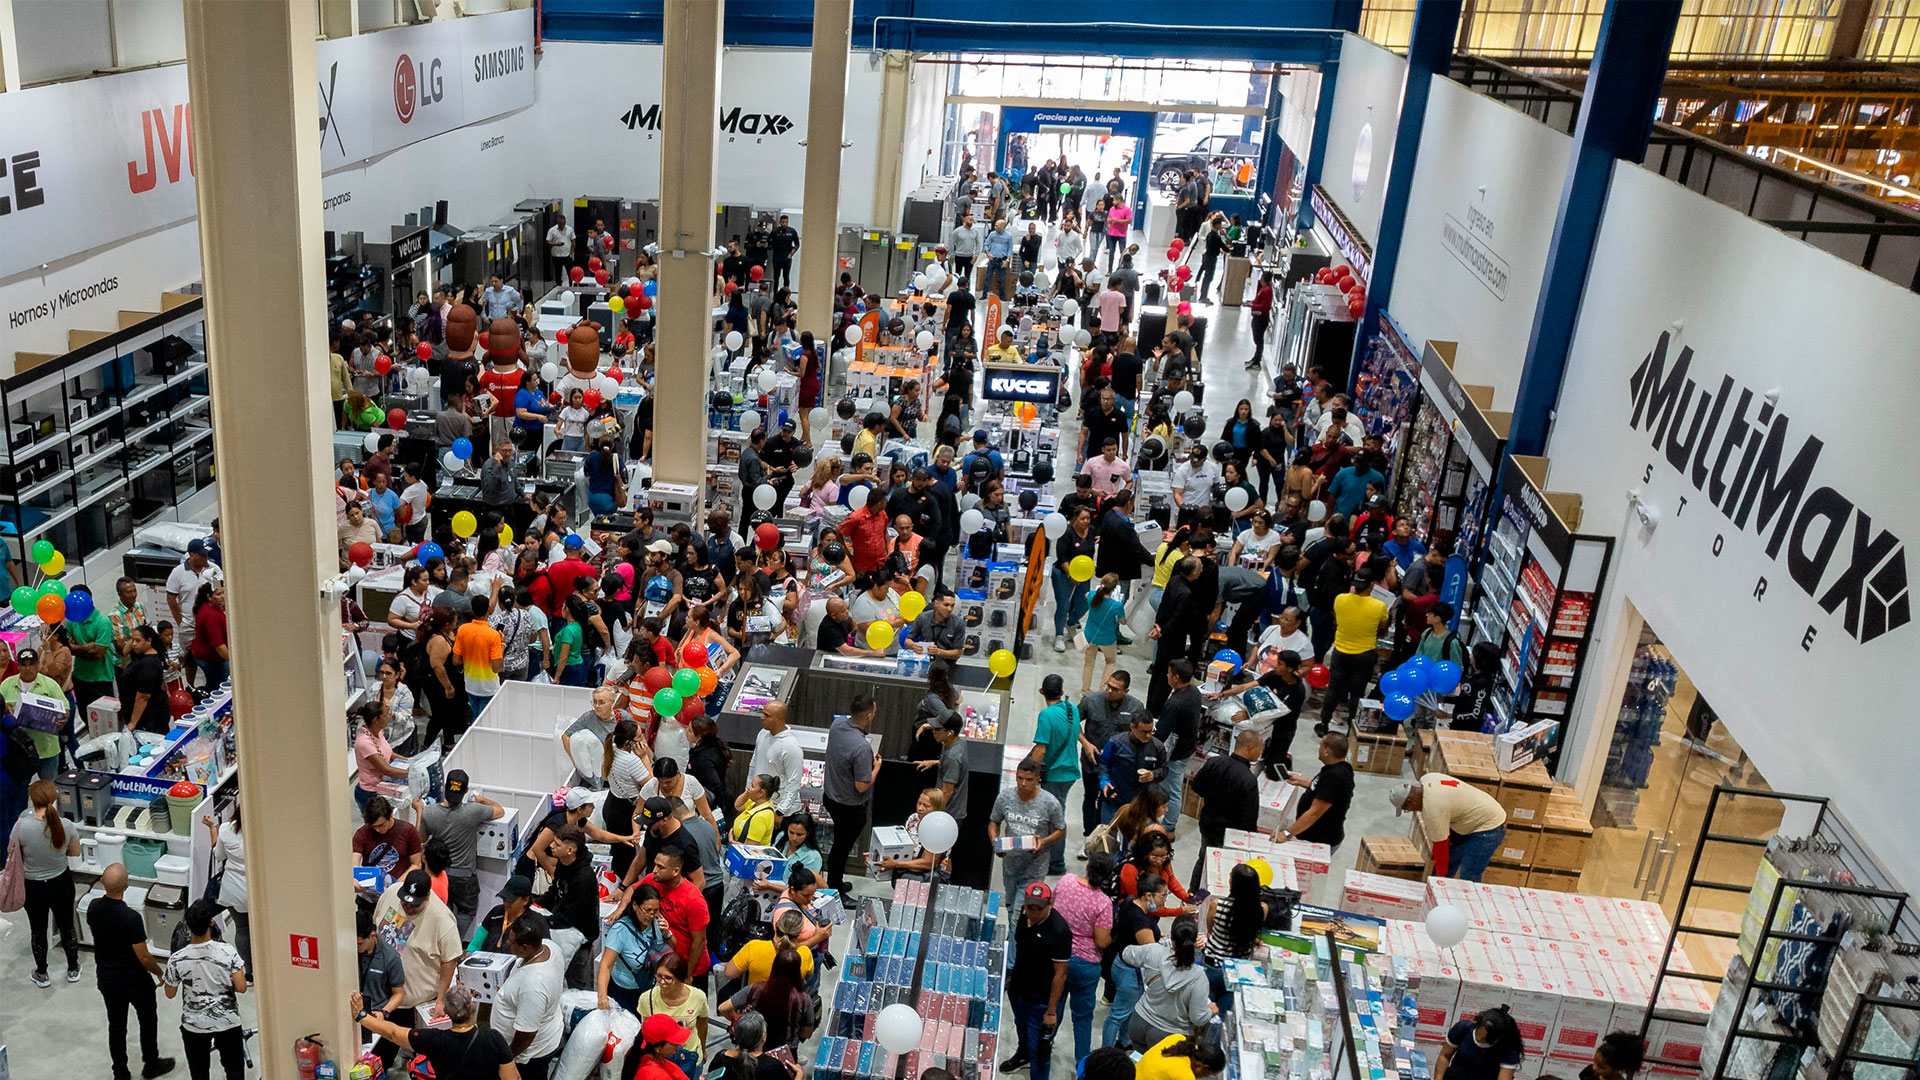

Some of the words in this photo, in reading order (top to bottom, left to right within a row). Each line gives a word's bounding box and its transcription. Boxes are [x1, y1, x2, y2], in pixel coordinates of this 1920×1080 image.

[419, 57, 444, 107] LG
[474, 45, 525, 83] SAMSUNG
[1033, 112, 1068, 122] ¡Gracias
[1068, 115, 1083, 124] por
[1084, 115, 1094, 123] tu
[1095, 115, 1121, 124] visita!
[127, 100, 195, 194] JV
[322, 191, 352, 212] ampanas
[9, 300, 49, 330] Hornos
[49, 298, 57, 319] y
[58, 276, 119, 310] Microondas
[1628, 329, 1904, 642] MultiMax
[112, 779, 167, 796] MultiMax
